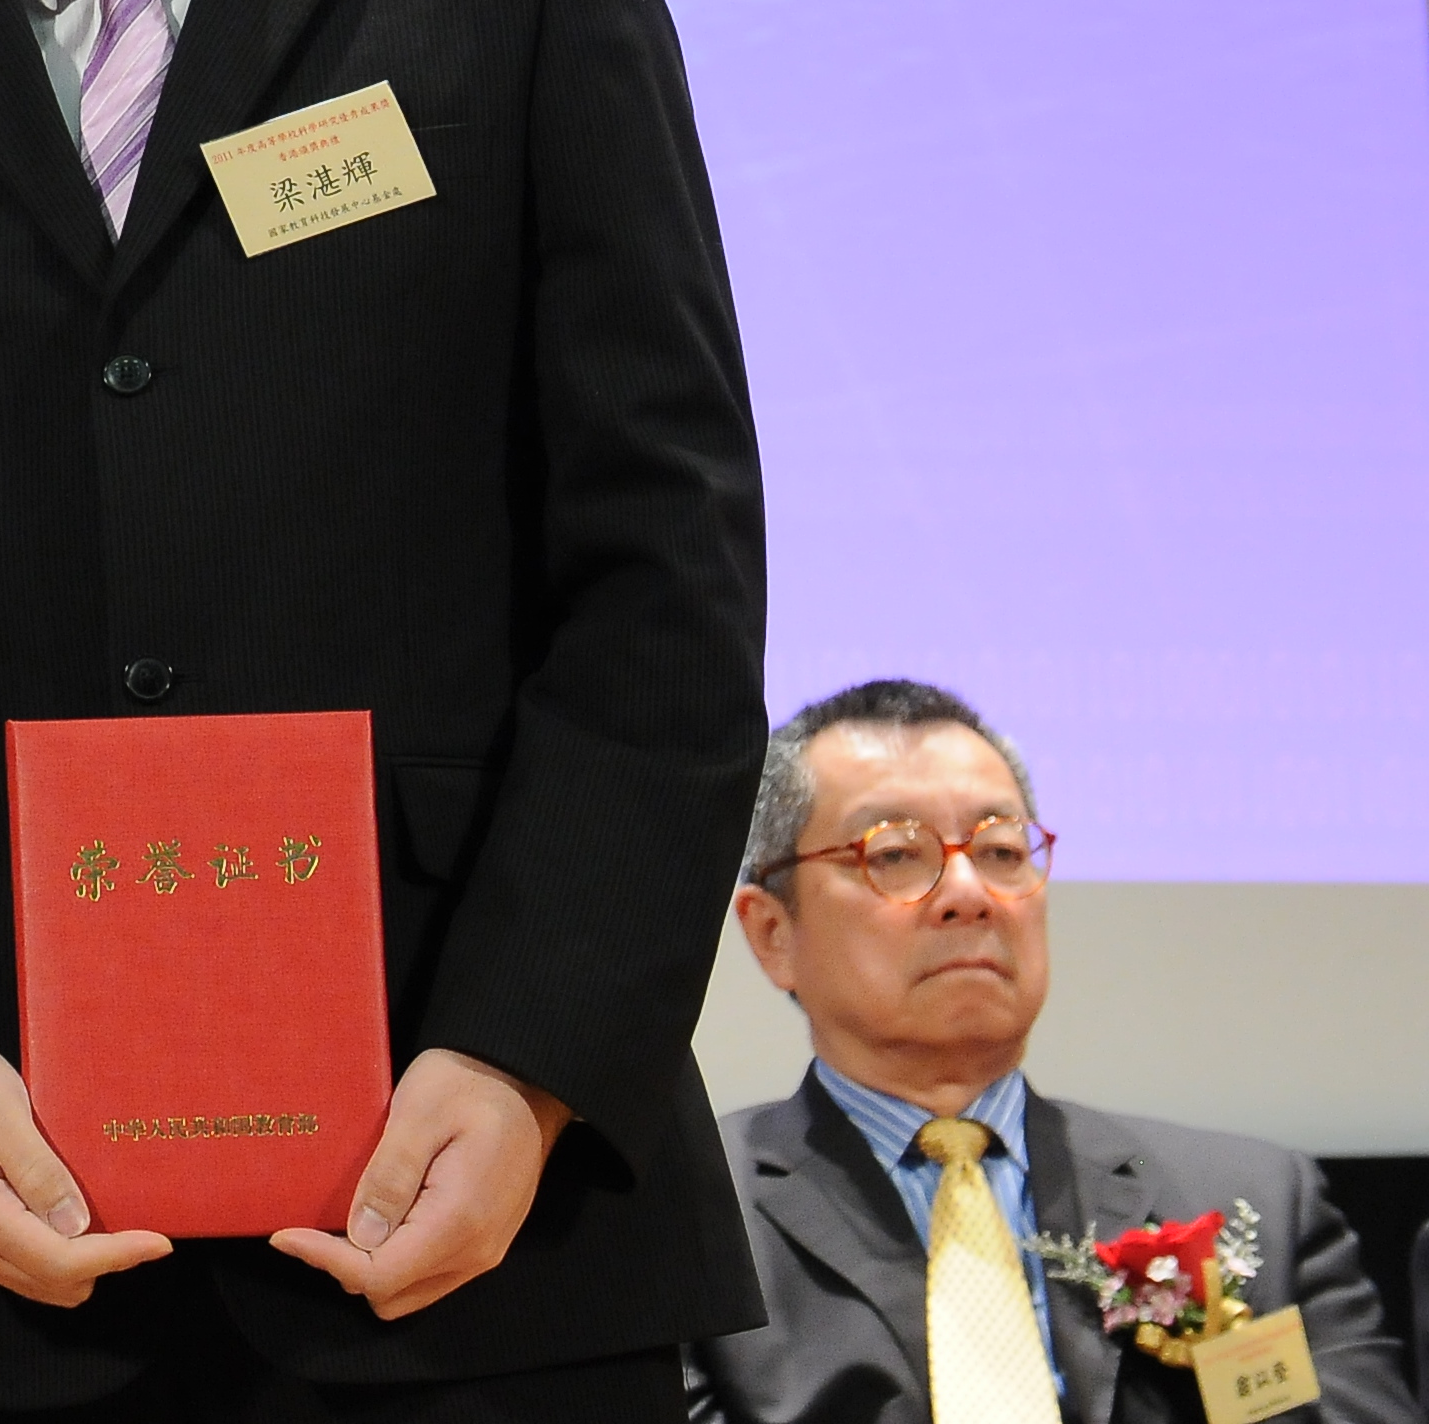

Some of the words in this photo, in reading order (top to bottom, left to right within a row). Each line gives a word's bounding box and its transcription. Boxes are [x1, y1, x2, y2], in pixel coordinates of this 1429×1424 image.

[269, 151, 380, 214] 梁湛輝
[70, 833, 323, 902] 荣誉证书
